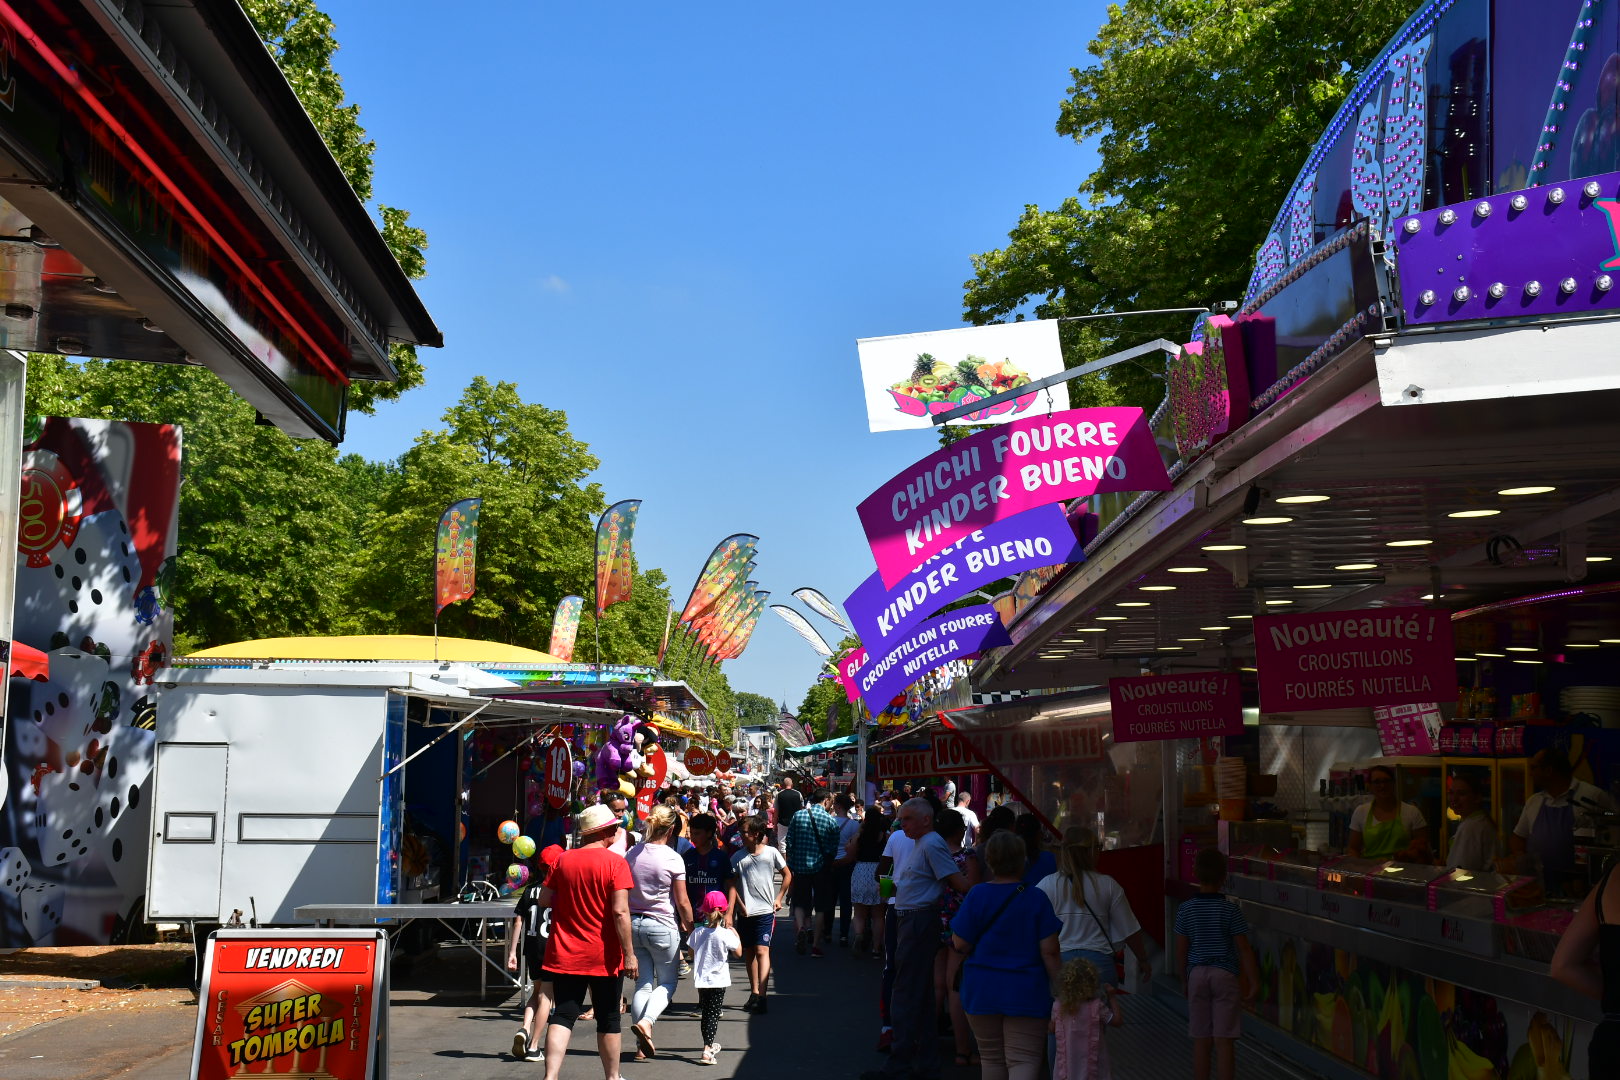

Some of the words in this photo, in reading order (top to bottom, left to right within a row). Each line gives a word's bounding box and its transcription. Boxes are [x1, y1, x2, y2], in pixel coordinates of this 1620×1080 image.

[892, 447, 981, 521] CHICHI
[992, 422, 1118, 462] FOURRE
[904, 474, 1011, 555] KINDER
[1020, 455, 1127, 491] BUENO
[877, 563, 959, 637] KINDER
[965, 537, 1052, 573] BUENO
[847, 652, 870, 677] GLA
[862, 627, 937, 692] CROUSTILLON
[940, 613, 994, 635] FOURRE
[903, 640, 959, 677] NUTELLA
[1298, 649, 1413, 671] CROUSTILLONS
[1285, 676, 1355, 700] FOURRÉS
[1362, 675, 1431, 695] NUTELLA
[1130, 718, 1175, 735] FOURRÉS
[1180, 718, 1226, 732] NUTELLA
[1138, 700, 1214, 716] CROUSTILLONS
[1011, 727, 1097, 760] CLAUDETTE
[551, 746, 566, 783] 1€
[687, 758, 706, 767] 1,50€
[879, 754, 926, 777] NOUGAT
[245, 947, 344, 970] VENDREDI
[212, 990, 228, 1046] CESAR
[246, 993, 322, 1032] SUPER
[350, 984, 364, 1050] PALACE
[229, 1018, 345, 1065] TOMBOLA
